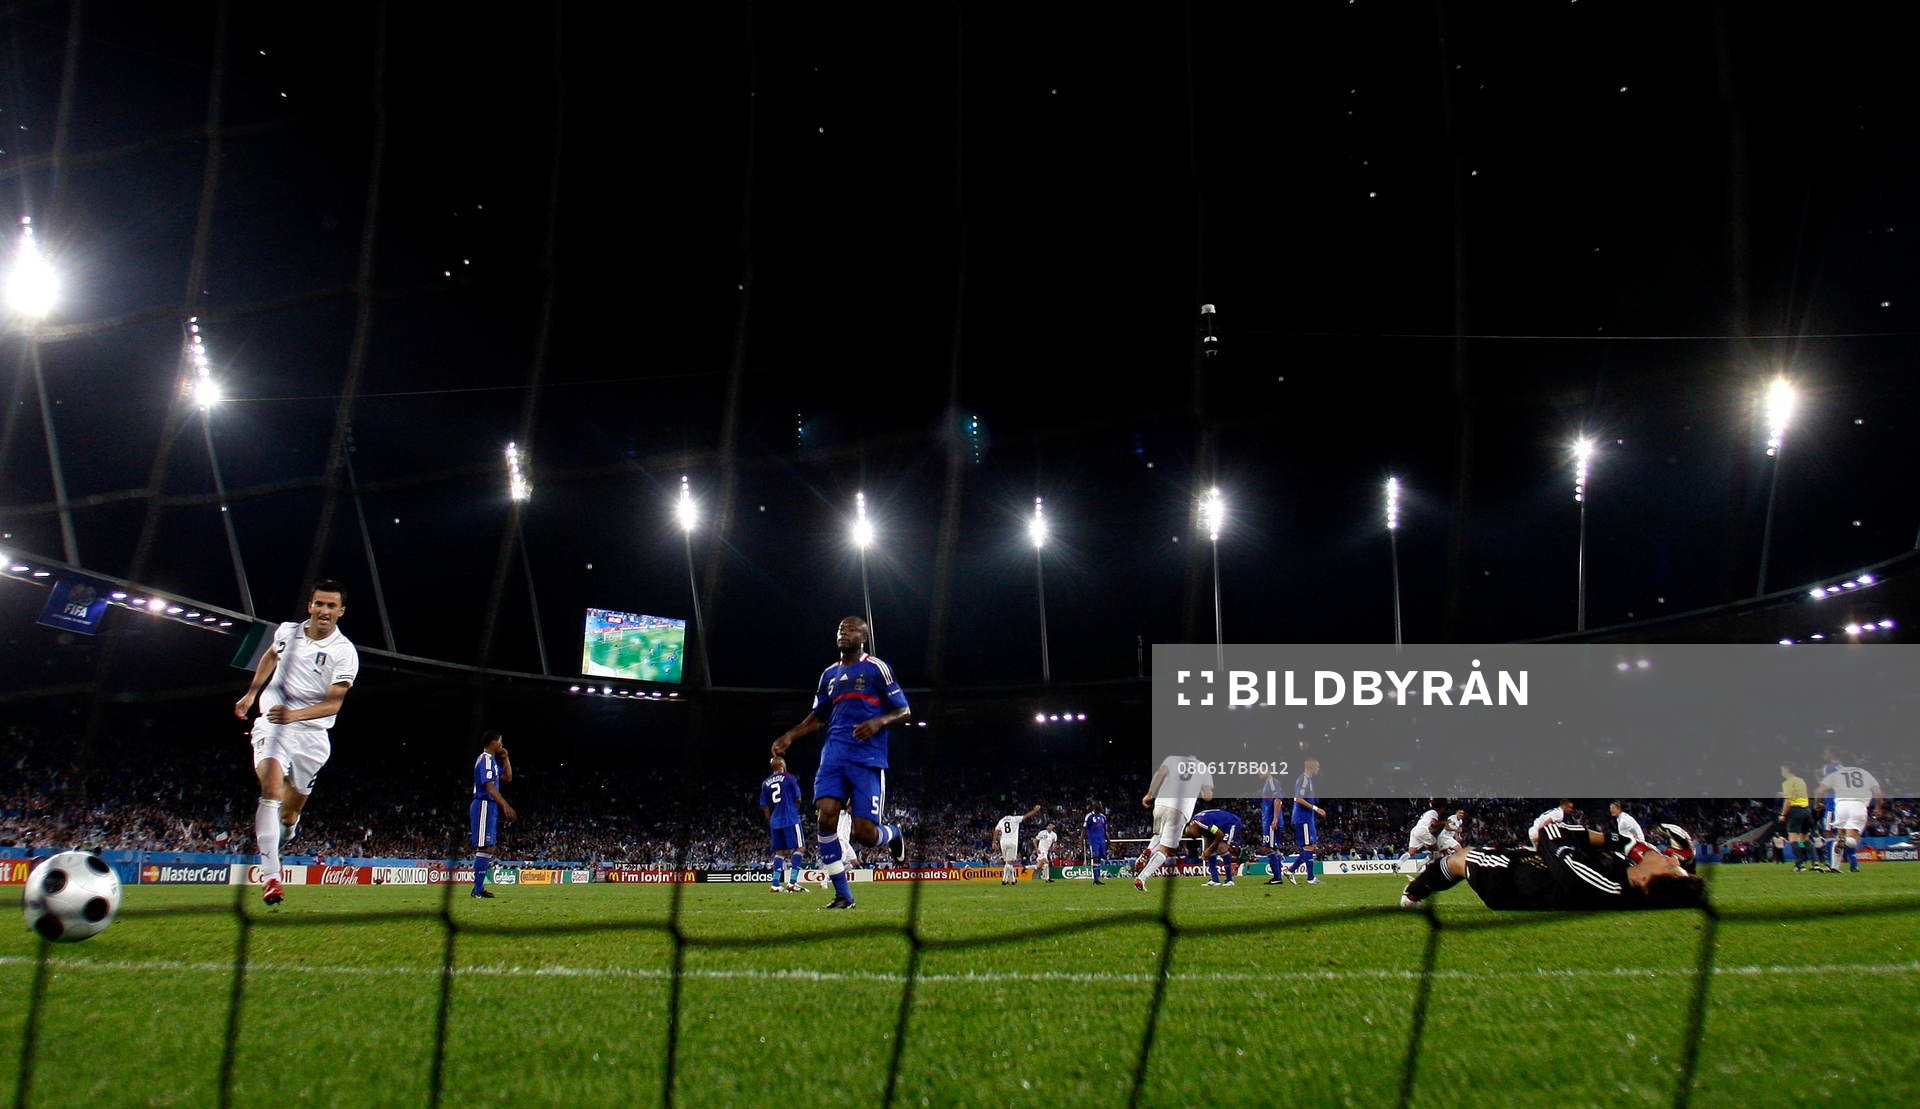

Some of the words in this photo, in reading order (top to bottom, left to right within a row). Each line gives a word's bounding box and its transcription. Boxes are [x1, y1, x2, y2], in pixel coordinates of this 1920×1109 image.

[64, 603, 88, 617] FIFA
[1840, 771, 1864, 788] 18
[770, 783, 782, 803] 2
[871, 795, 880, 814] 5
[1004, 821, 1012, 834] 8
[160, 866, 227, 882] MasterCard
[621, 871, 639, 882] i'm
[733, 871, 773, 882] adidas
[803, 870, 855, 881] Can
[886, 871, 948, 880] McDonald's
